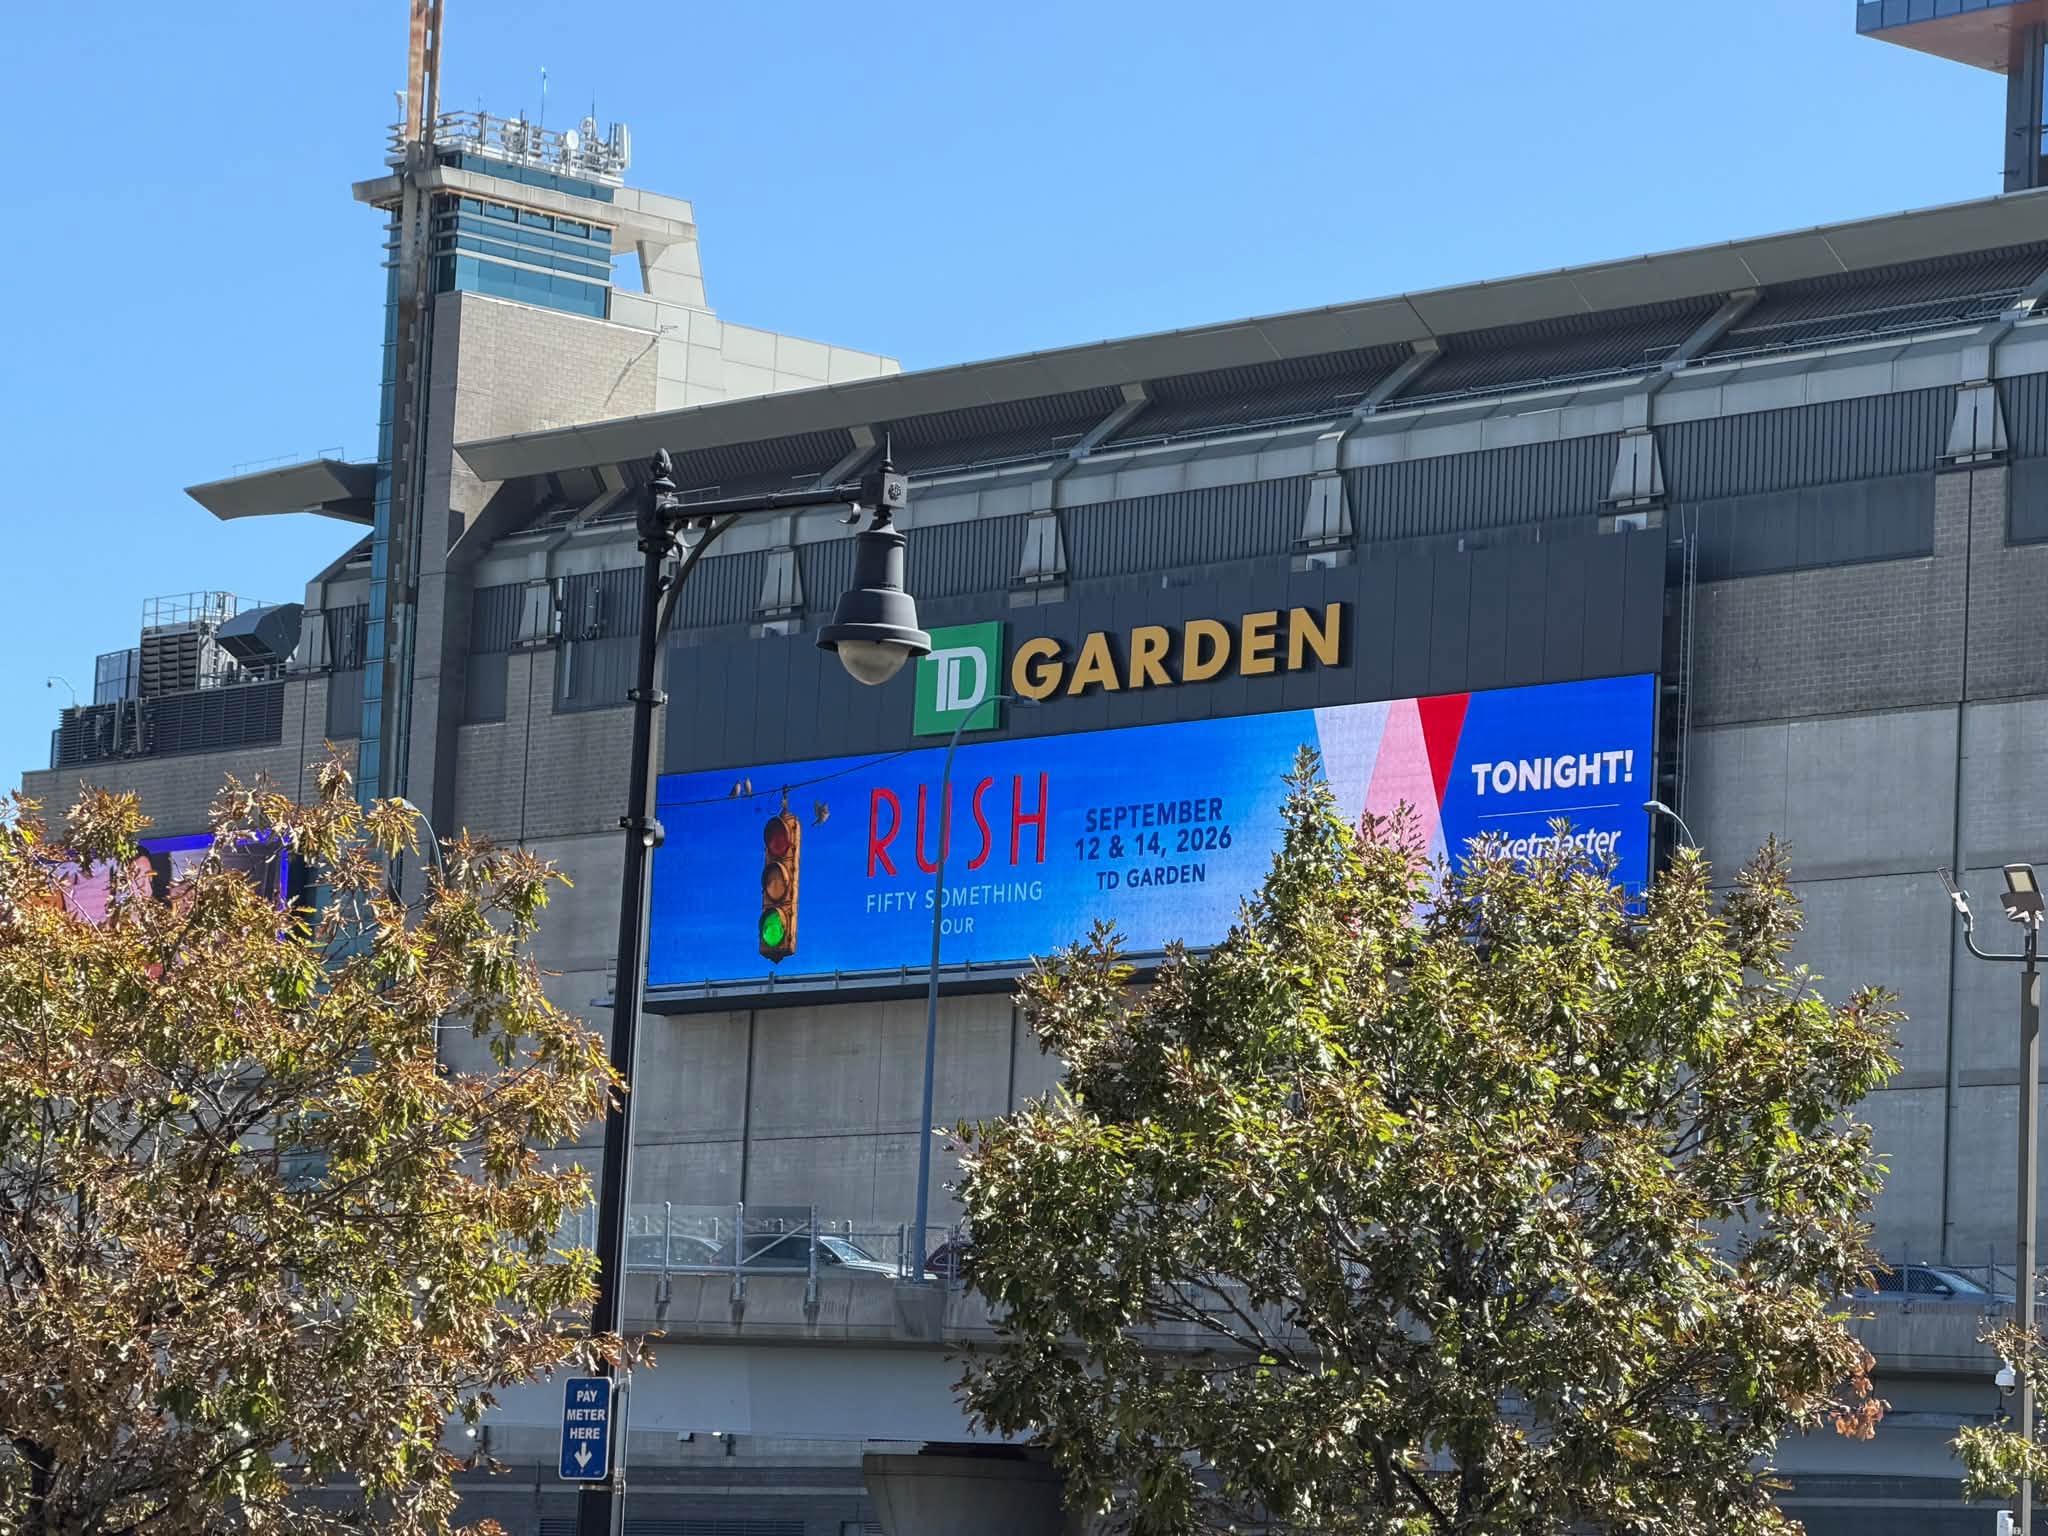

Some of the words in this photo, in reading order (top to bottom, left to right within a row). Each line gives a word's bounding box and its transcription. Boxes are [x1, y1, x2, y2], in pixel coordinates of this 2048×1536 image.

[925, 646, 988, 712] TD
[1011, 603, 1341, 700] GARDEN
[1472, 750, 1634, 796] TONIGHT!
[867, 772, 1049, 878] RUSH
[1085, 797, 1223, 833] SEPTEMBER
[1075, 836, 1101, 861] 12
[1108, 834, 1125, 859] &
[1135, 831, 1168, 859] 14,
[1176, 825, 1233, 853] 2026
[1096, 871, 1120, 891] TD
[1126, 863, 1206, 889] GARDEN
[866, 891, 917, 914] FIFTY
[925, 880, 1043, 910] SOMETHING
[931, 917, 975, 936] OUR
[576, 1390, 598, 1403] PAY
[567, 1408, 606, 1421] METER
[569, 1427, 601, 1440] HERE
